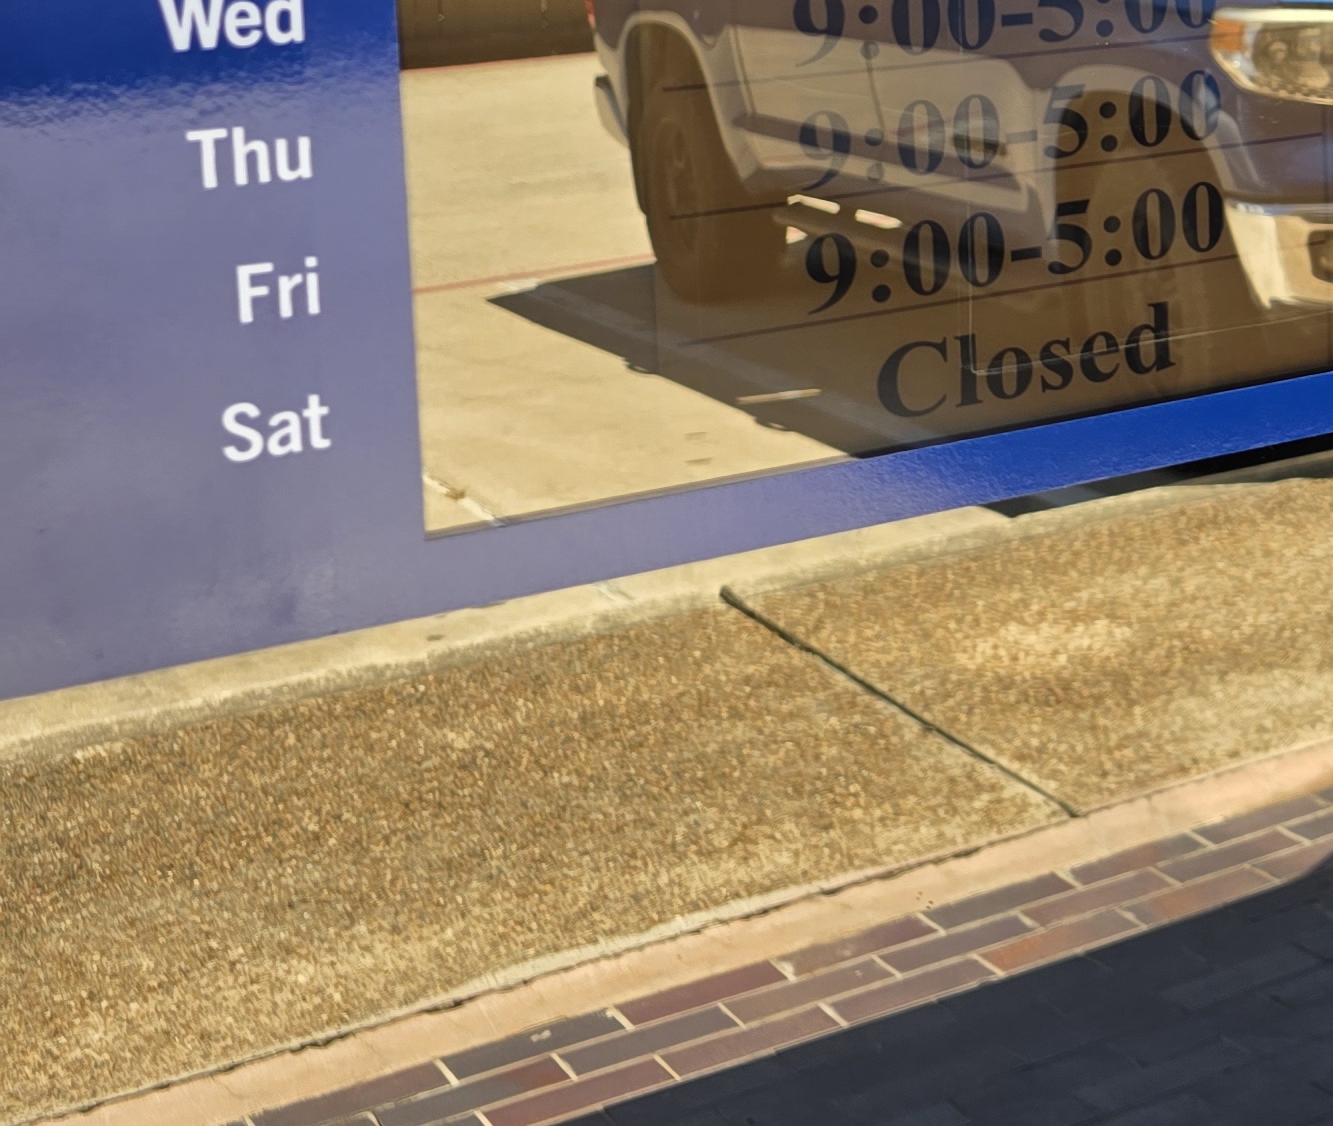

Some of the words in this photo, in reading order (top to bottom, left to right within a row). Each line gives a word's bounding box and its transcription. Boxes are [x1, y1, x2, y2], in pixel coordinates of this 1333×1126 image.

[185, 126, 313, 189] Thu
[799, 69, 1222, 191] 9:00-5:00
[236, 256, 321, 324] Fri
[804, 181, 1225, 316] 9:00-5:00
[876, 302, 1177, 419] Closed
[222, 393, 332, 462] Sat
